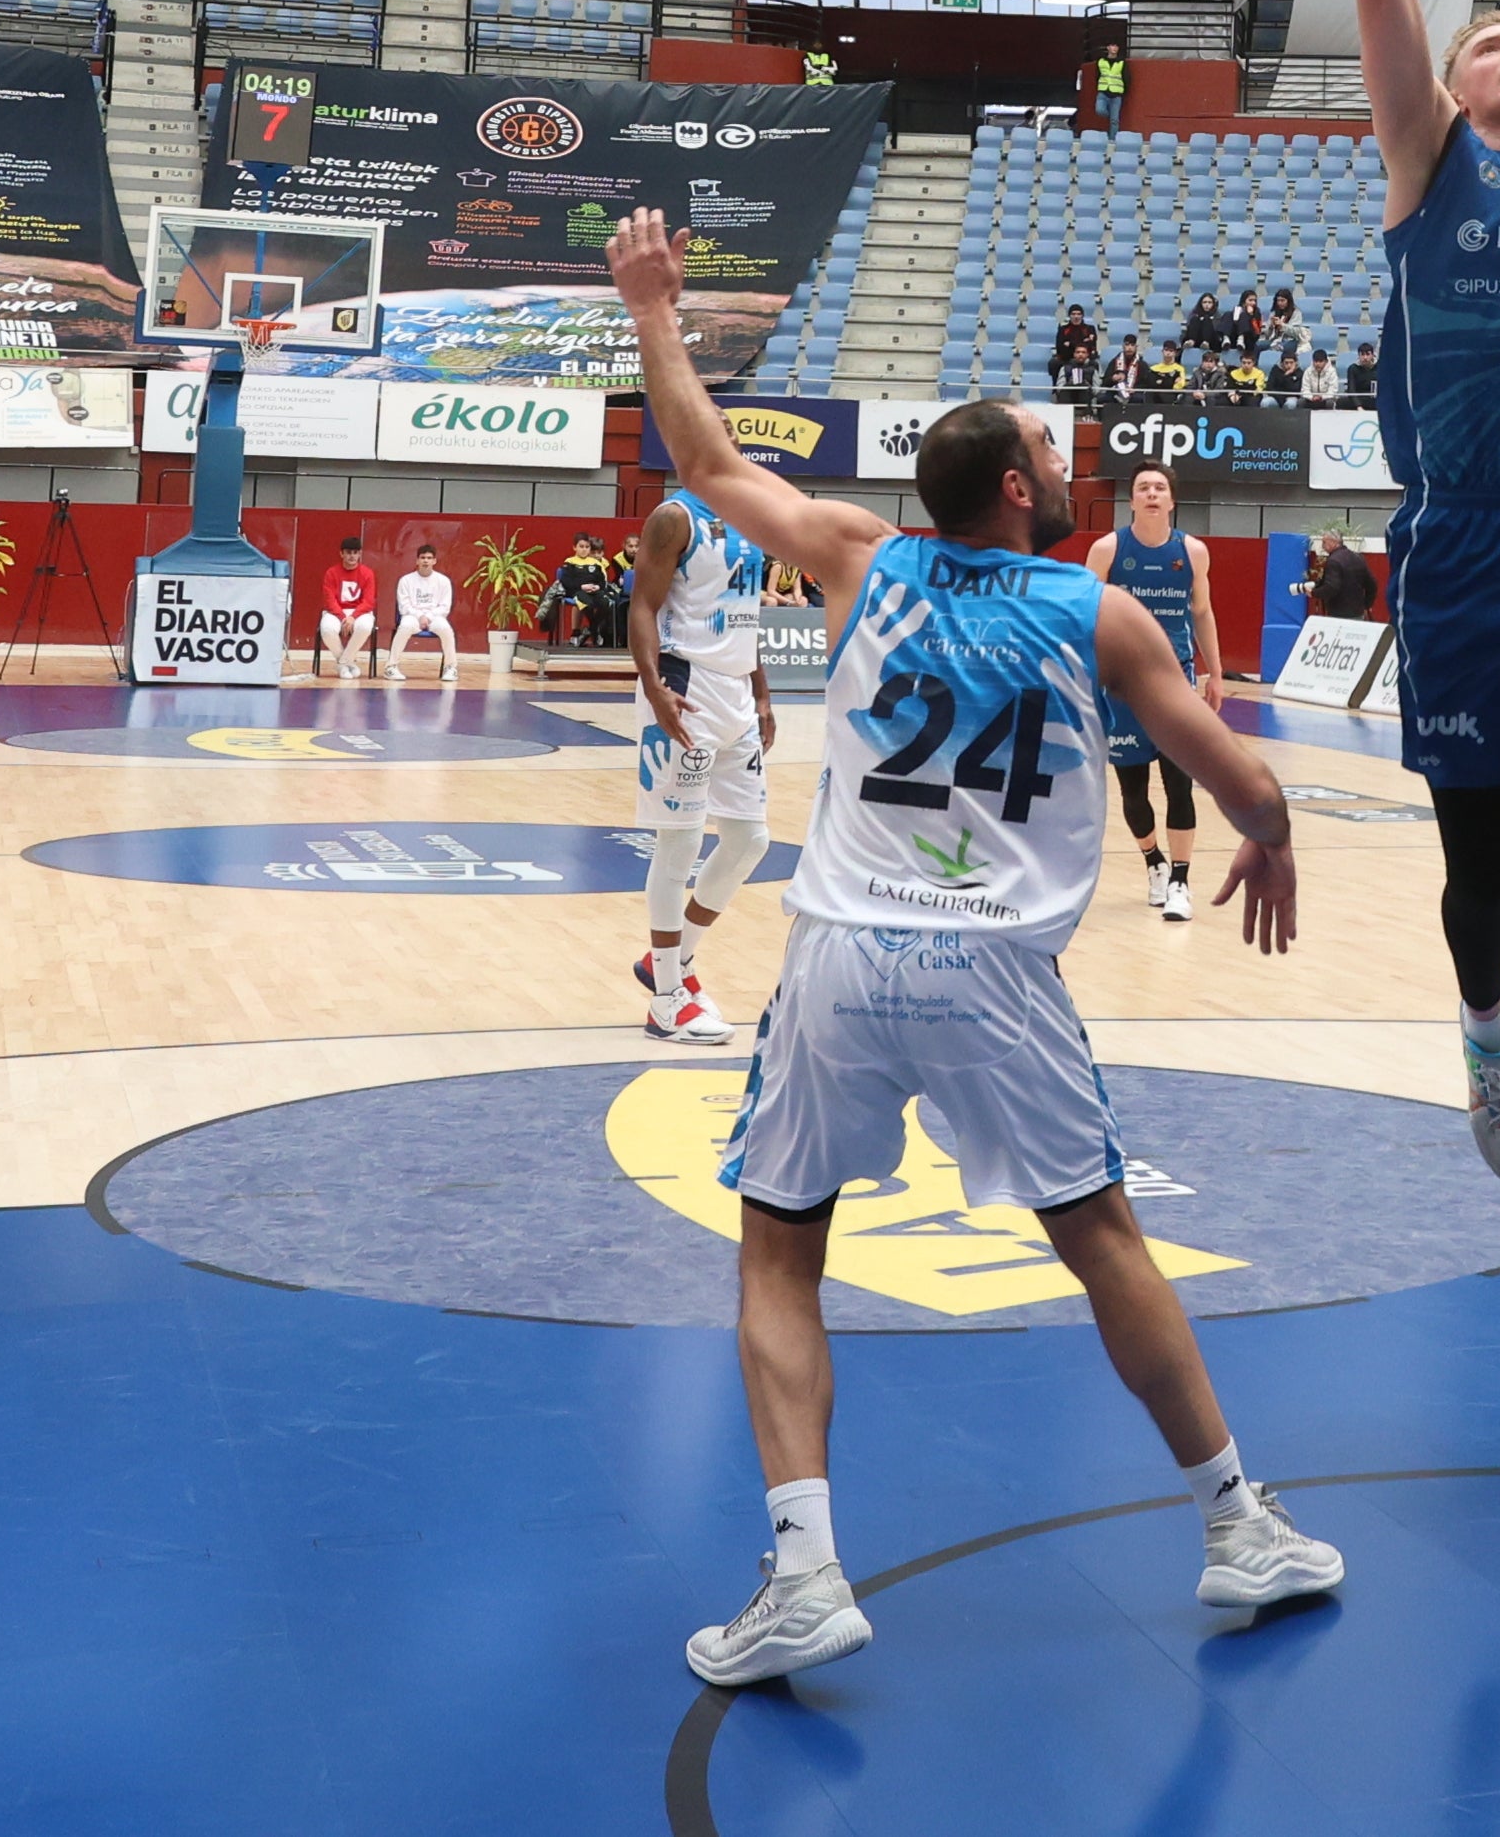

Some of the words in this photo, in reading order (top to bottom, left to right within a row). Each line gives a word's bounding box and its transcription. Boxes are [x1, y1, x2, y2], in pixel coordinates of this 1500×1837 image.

[244, 73, 312, 97] 04:19
[256, 92, 298, 104] MONDO
[260, 104, 290, 142] 7
[313, 103, 439, 125] aturklima
[324, 169, 432, 184] handiak
[357, 160, 441, 175] txikiek
[298, 176, 417, 192] ditzakete
[280, 191, 402, 207] pequeños
[343, 206, 439, 218] pueden
[552, 375, 573, 388] TU
[411, 394, 570, 435] ékolo
[409, 435, 476, 449] produktu
[481, 438, 568, 452] ekologikoak
[743, 452, 781, 463] NORTE
[1233, 447, 1279, 460] servicio
[1281, 449, 1298, 460] de
[1232, 459, 1298, 472] prevención
[728, 563, 757, 596] 41
[927, 552, 1033, 598] DANI
[157, 580, 193, 605] EL
[1132, 586, 1187, 599] Naturklima
[154, 608, 265, 635] DIARIO
[151, 637, 259, 664] VASCO
[859, 670, 1054, 824] 24
[868, 877, 1021, 922] Extremadura
[932, 931, 961, 949] del
[918, 949, 976, 972] Casar
